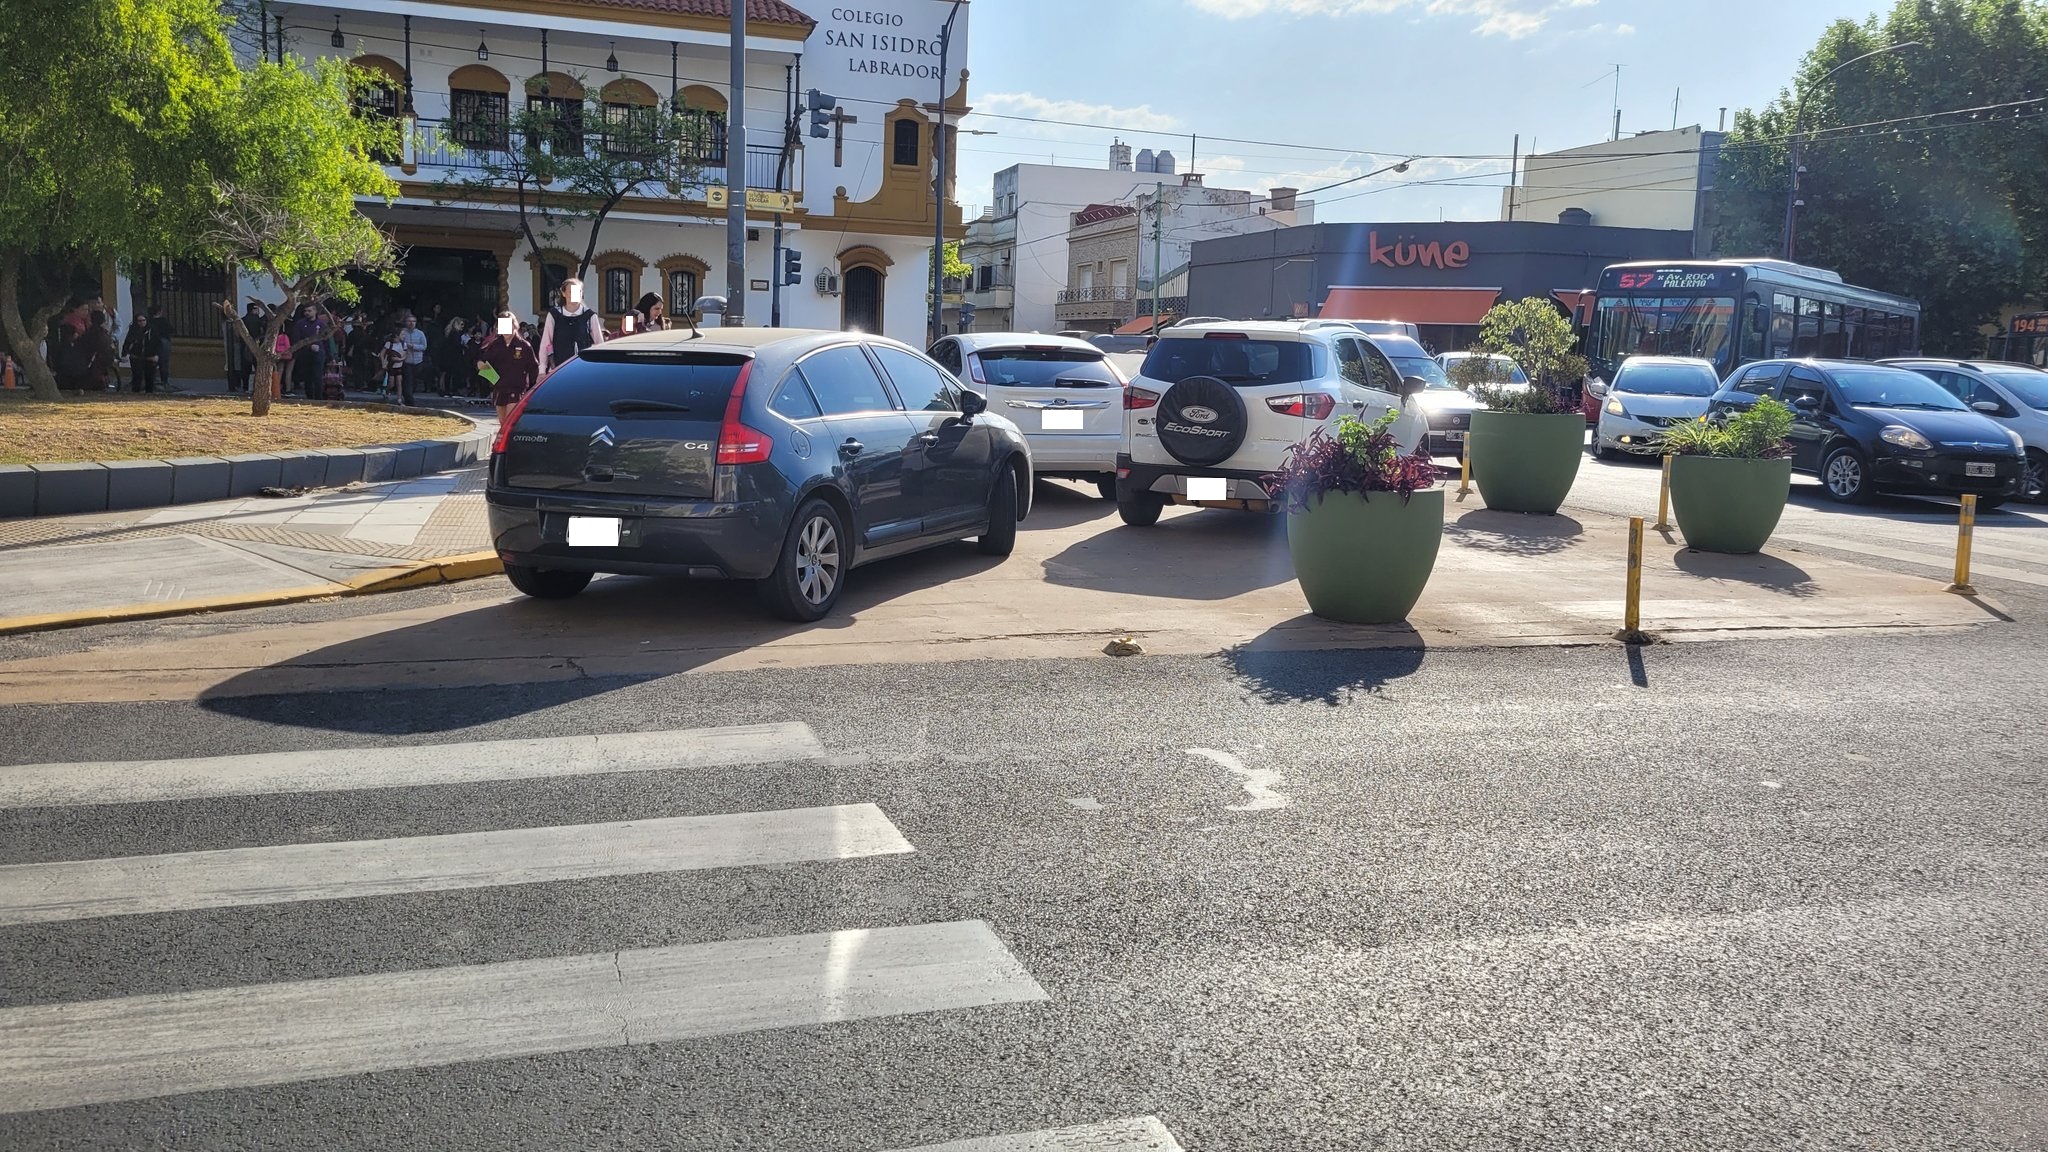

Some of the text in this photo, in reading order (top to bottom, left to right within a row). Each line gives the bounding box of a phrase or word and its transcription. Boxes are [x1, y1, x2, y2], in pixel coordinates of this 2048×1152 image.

[832, 8, 903, 27] COLEGIO
[825, 30, 943, 57] SAN ISIDRO
[849, 58, 943, 80] LABRADOR
[1369, 230, 1470, 270] küne
[1619, 273, 1654, 288] 57
[1663, 280, 1707, 288] PALERMO
[2014, 319, 2036, 332] 194
[1189, 408, 1211, 419] Ford
[684, 442, 709, 451] C4
